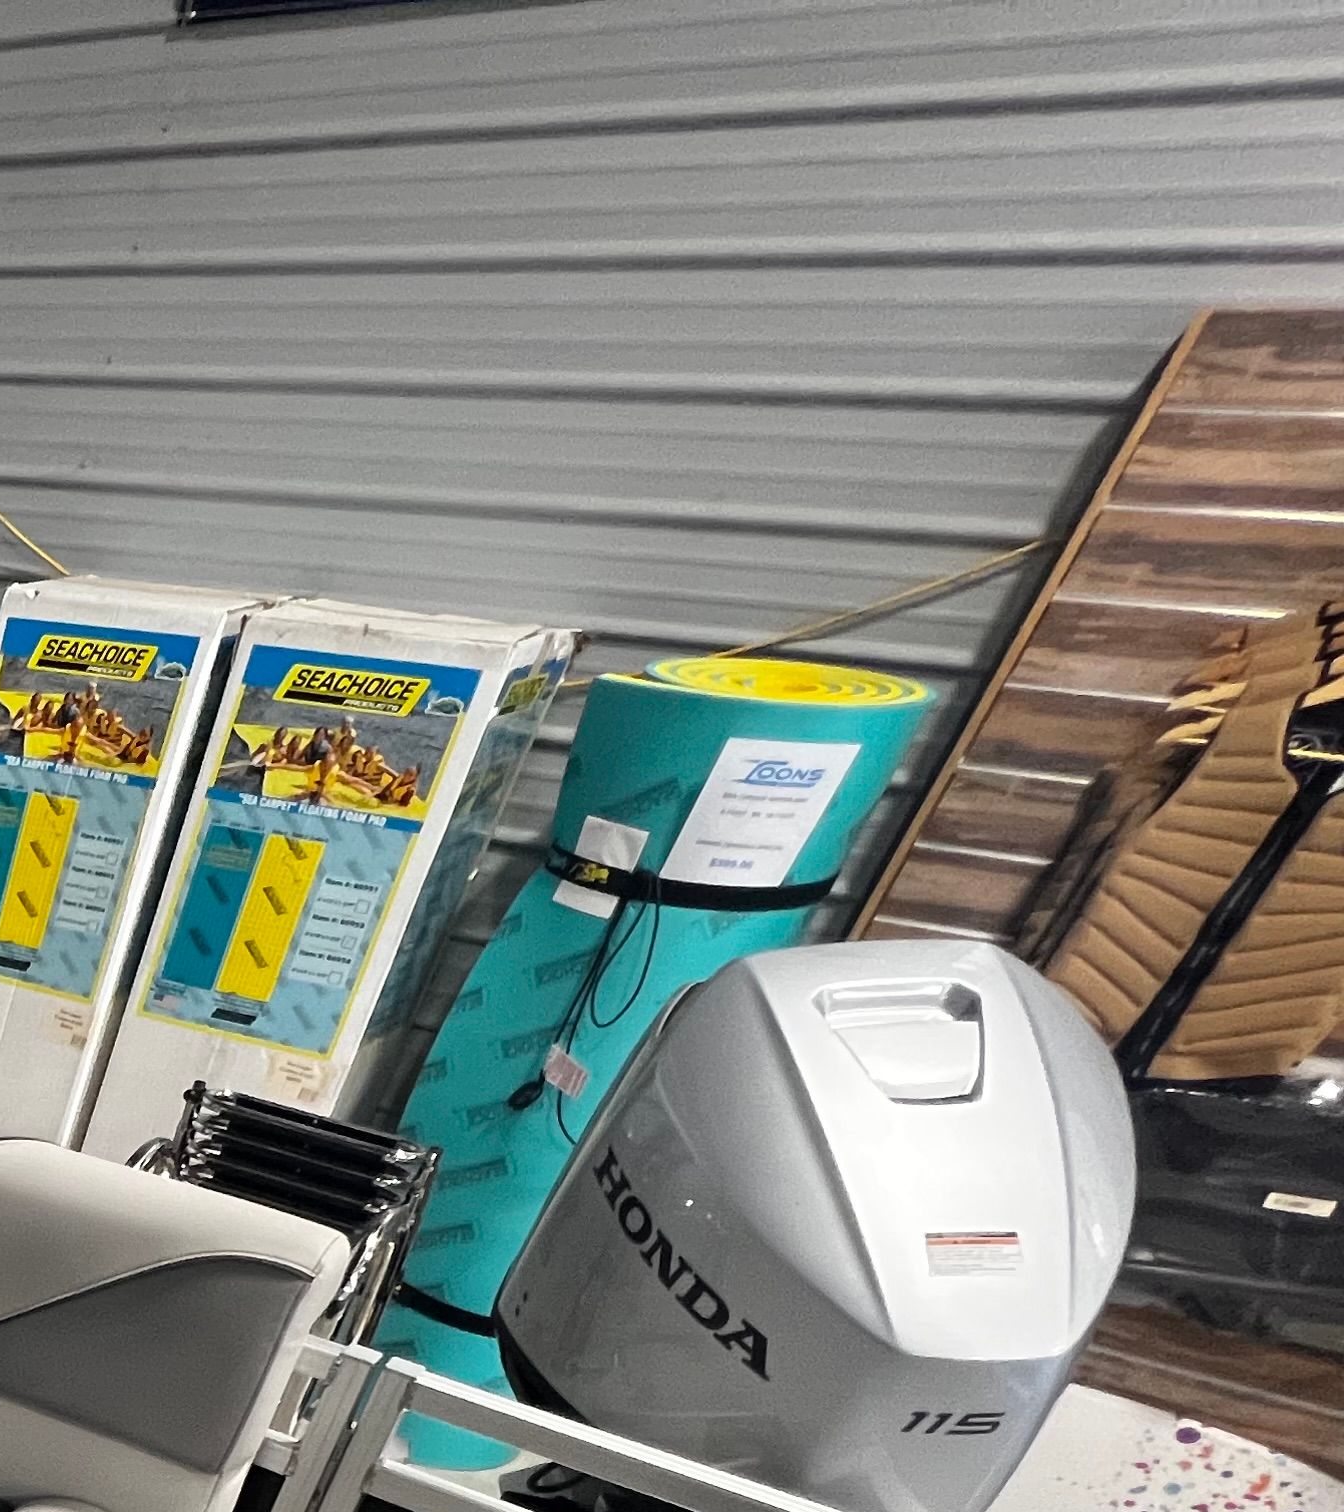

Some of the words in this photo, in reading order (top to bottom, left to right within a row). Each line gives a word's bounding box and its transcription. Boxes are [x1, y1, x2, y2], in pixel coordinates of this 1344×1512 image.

[42, 638, 149, 668] SEACHOICE
[291, 668, 419, 701] SEACHOICE
[593, 1146, 770, 1382] HONDA
[900, 1411, 1006, 1436] 115
